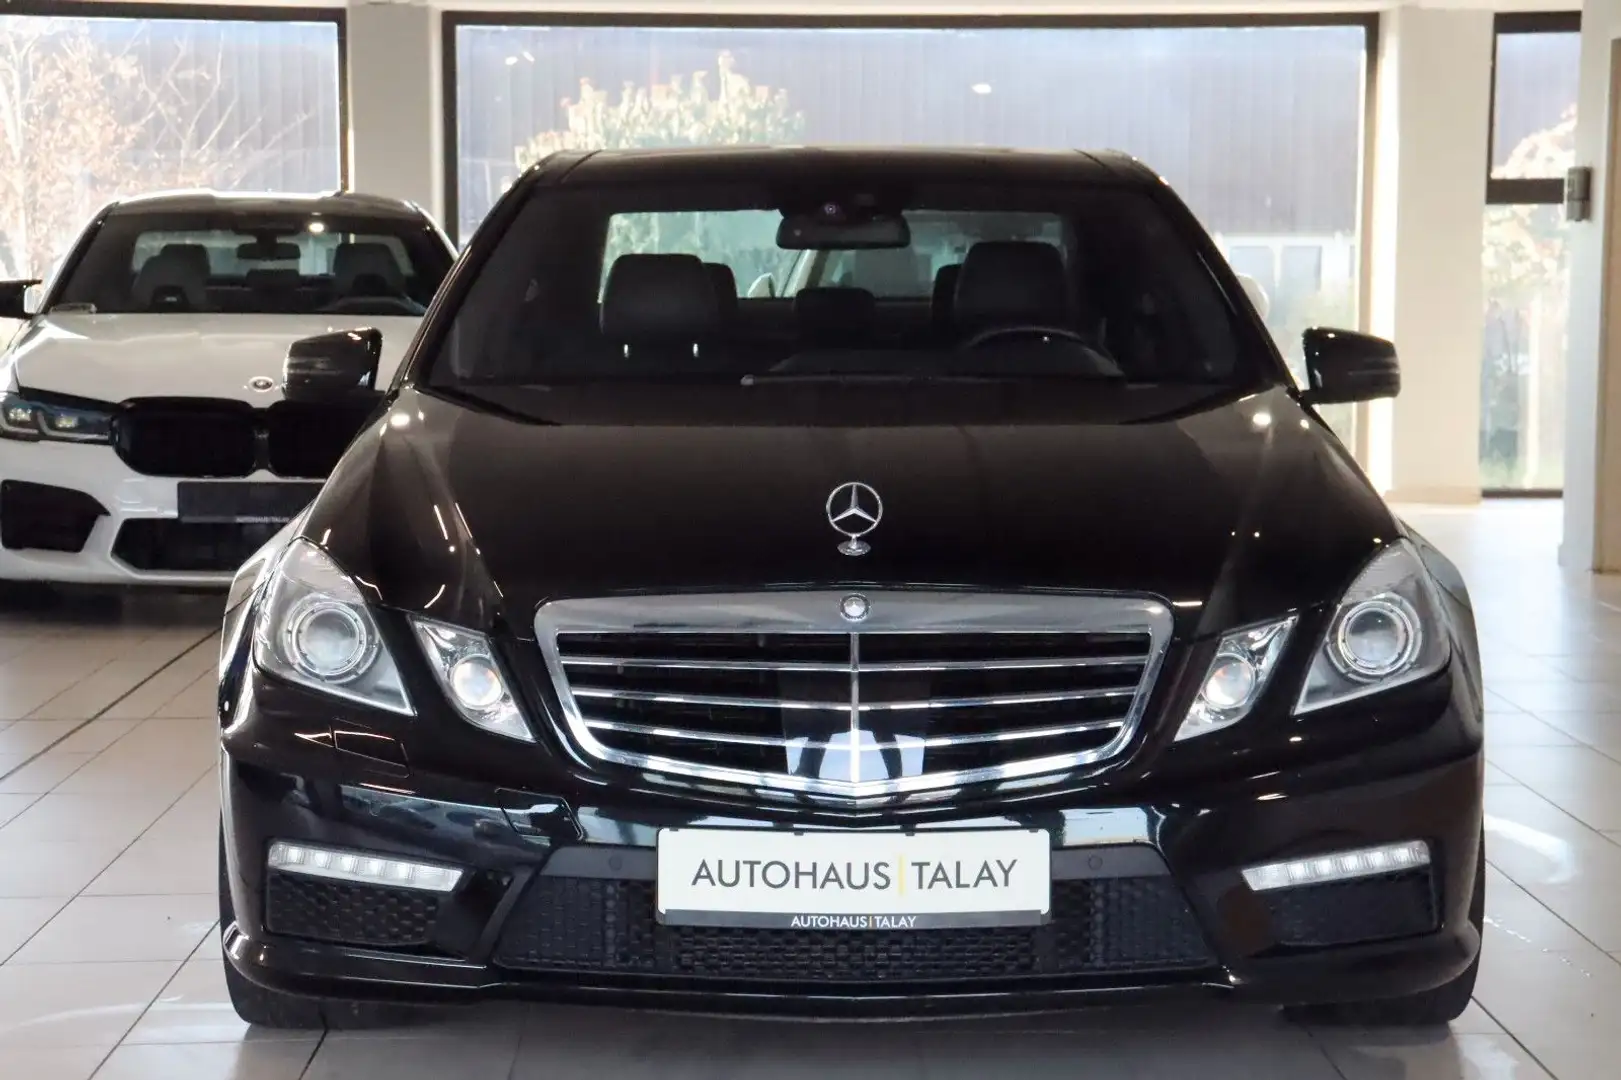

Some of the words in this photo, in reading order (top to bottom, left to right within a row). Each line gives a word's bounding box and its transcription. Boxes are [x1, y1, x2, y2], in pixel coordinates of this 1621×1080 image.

[691, 858, 891, 890] AUTOHAUS
[911, 859, 1018, 890] TALAY
[790, 915, 868, 928] AUTOHAUS
[874, 915, 917, 928] TALAY
